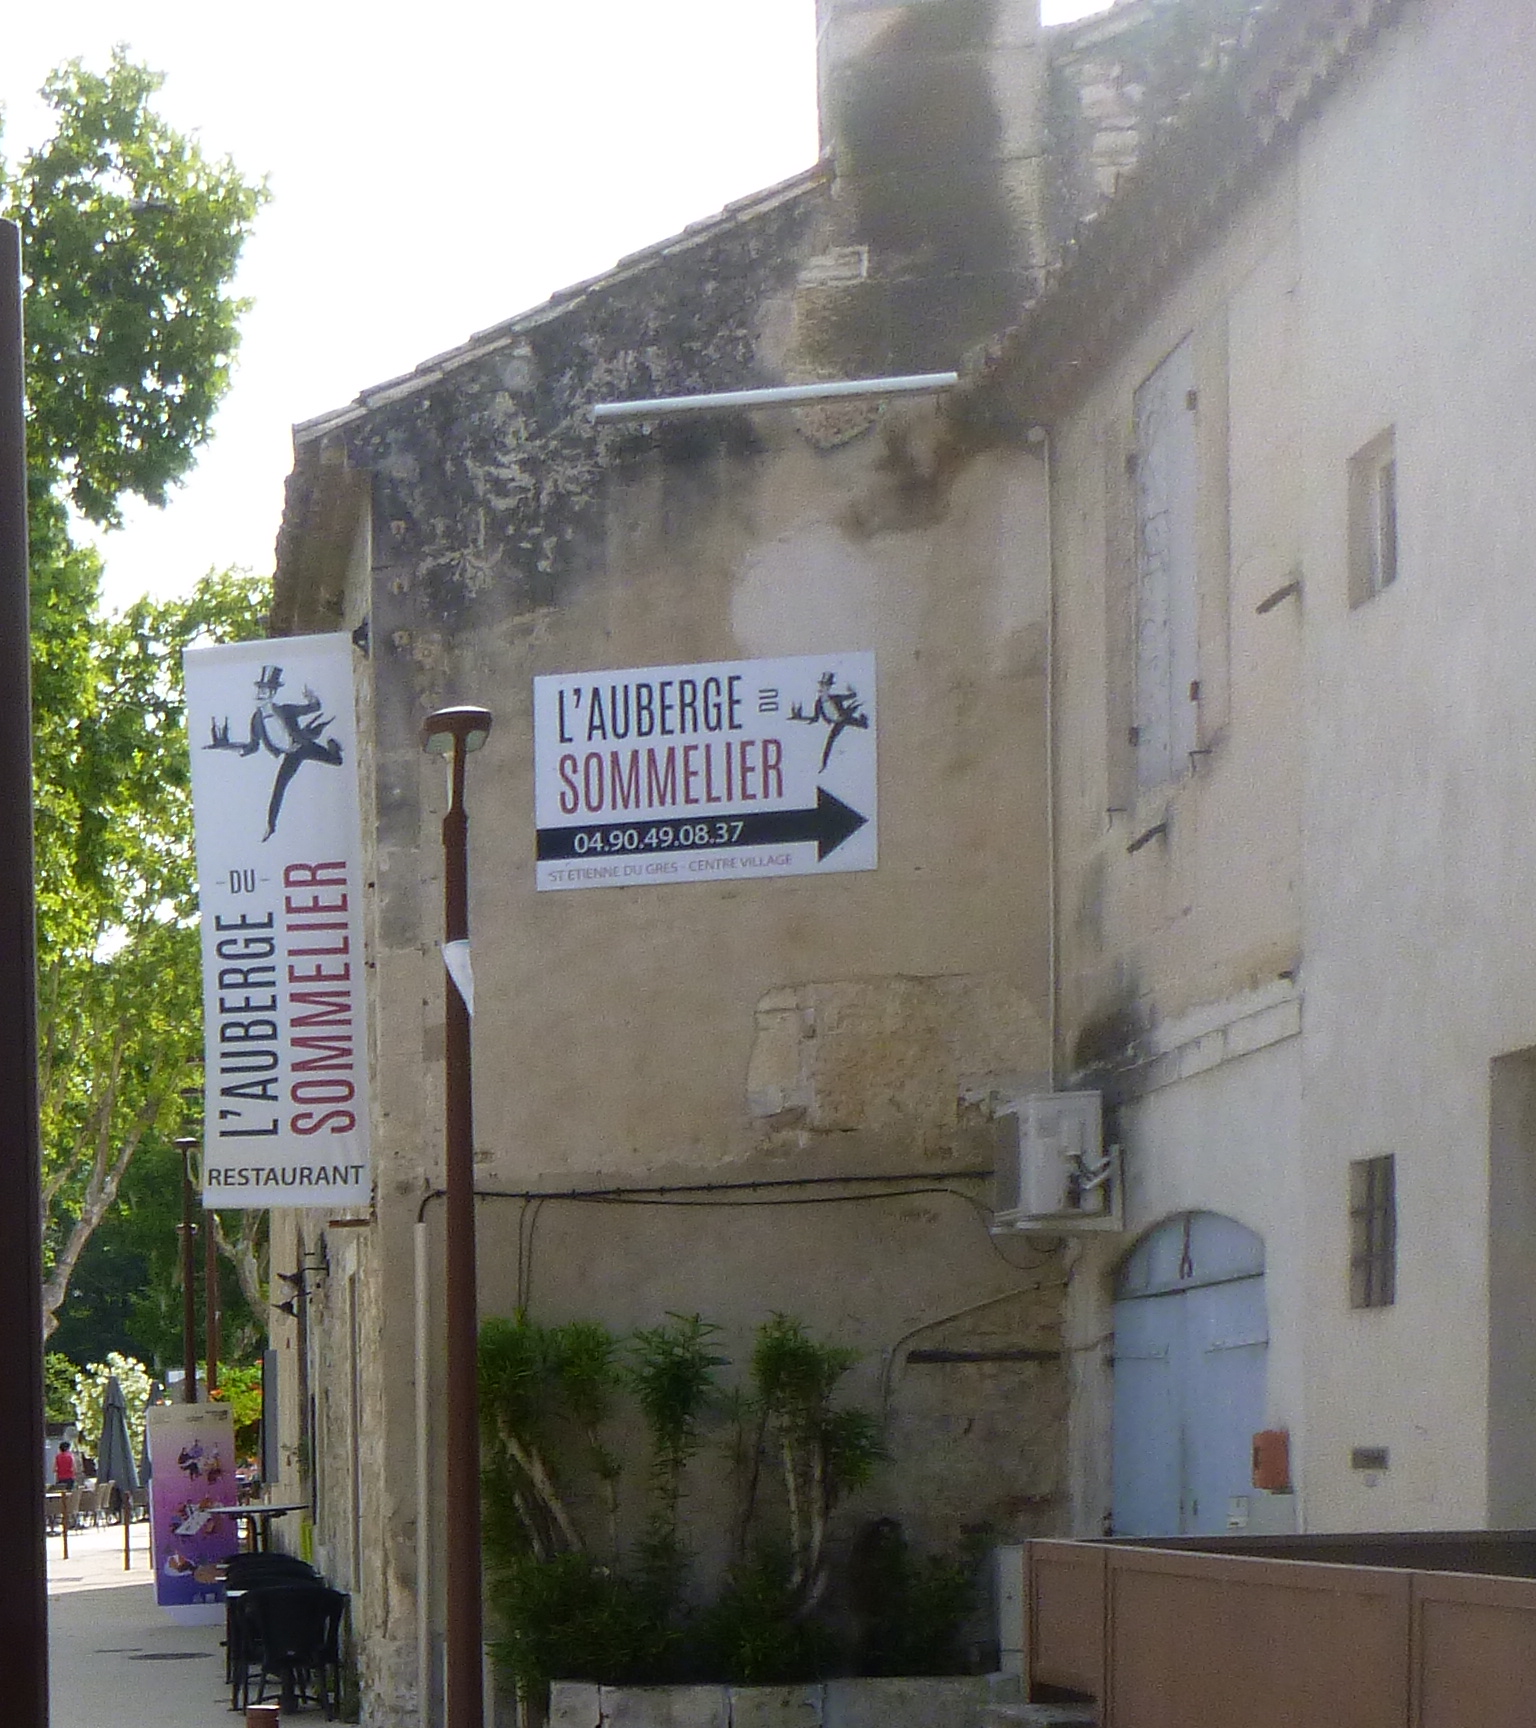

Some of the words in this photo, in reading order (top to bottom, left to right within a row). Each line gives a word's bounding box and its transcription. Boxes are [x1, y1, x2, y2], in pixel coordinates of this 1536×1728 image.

[558, 675, 743, 744] L'AUBERGE
[758, 688, 779, 713] DU
[559, 738, 784, 815] SOMMELIER
[574, 821, 744, 855] 04.90.49.08.37
[230, 869, 255, 894] DU
[624, 864, 643, 876] DU
[688, 856, 738, 872] CENTRE
[739, 853, 793, 869] VILLAGE
[283, 861, 356, 1136] SOMMELIER
[215, 911, 279, 1138] L'AUBERGE
[207, 1165, 364, 1187] RESTAURANT
